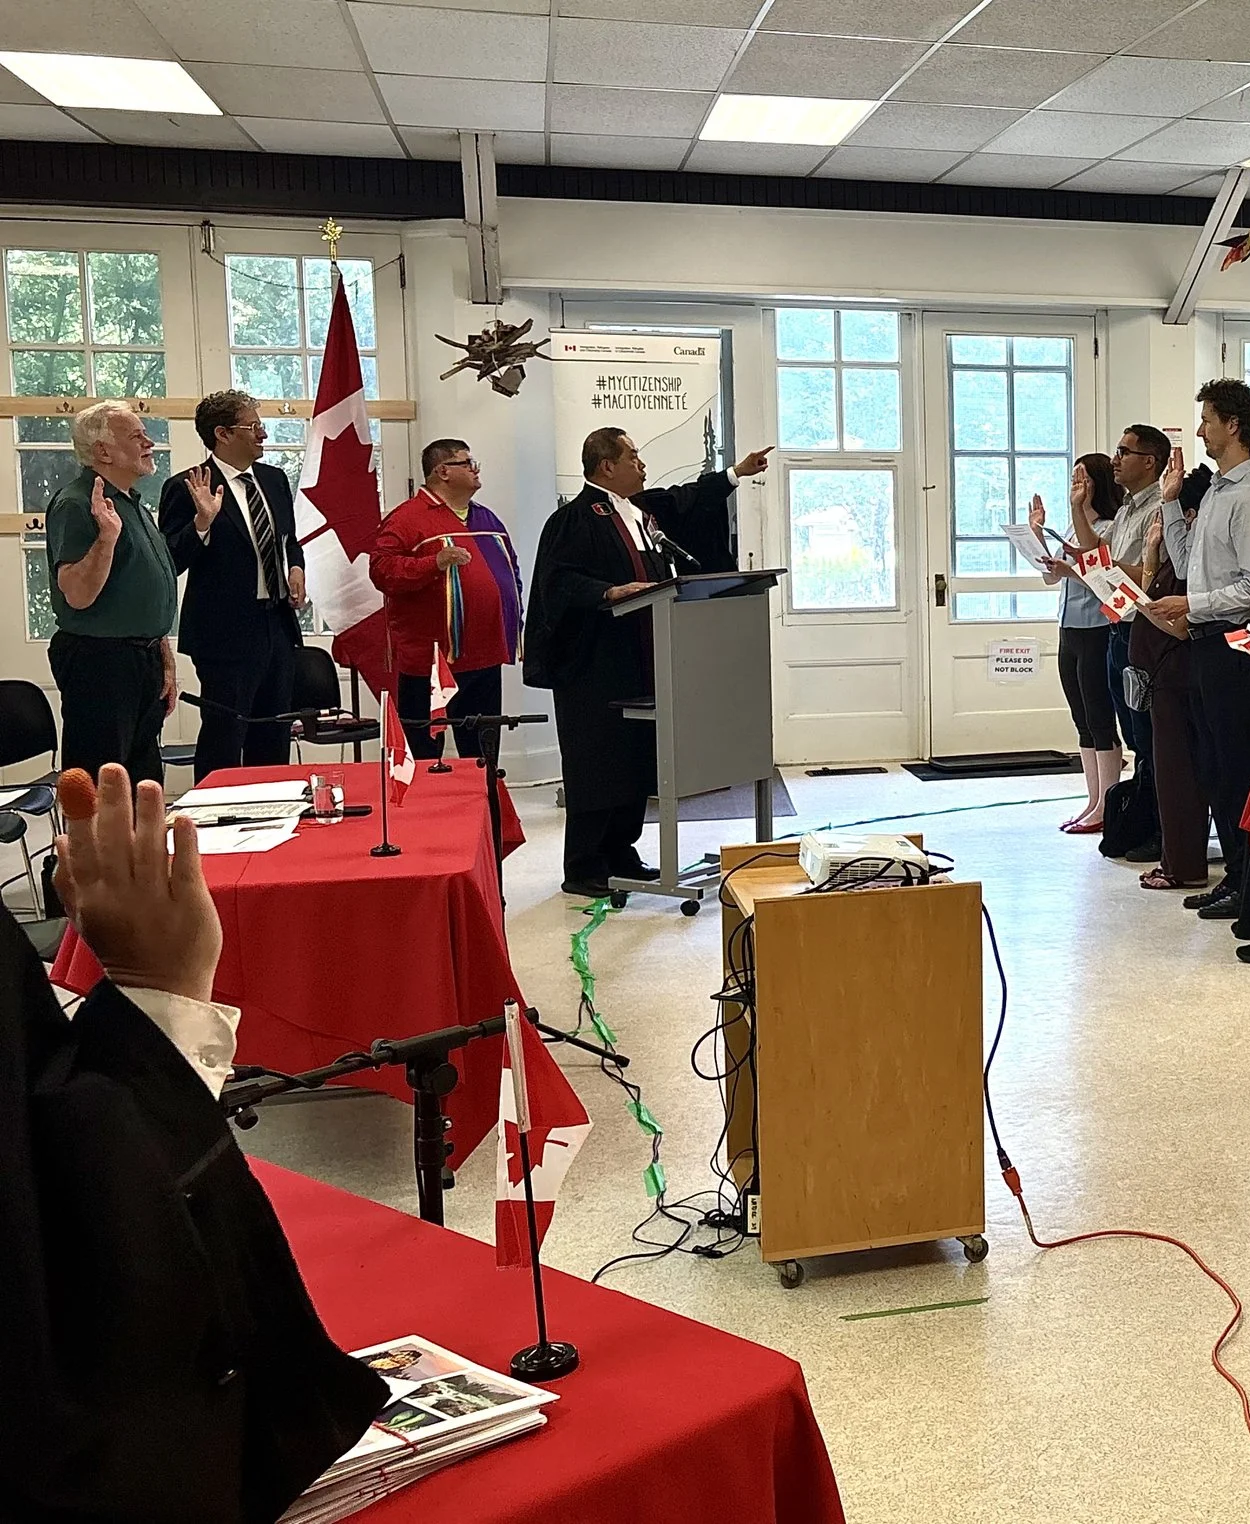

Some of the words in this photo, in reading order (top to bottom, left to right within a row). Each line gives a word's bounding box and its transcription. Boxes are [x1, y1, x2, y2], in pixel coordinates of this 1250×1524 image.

[673, 346, 706, 356] Canada
[596, 375, 682, 392] #MYCITIZENSHIP
[591, 392, 688, 410] #MACITOYENNETÉ
